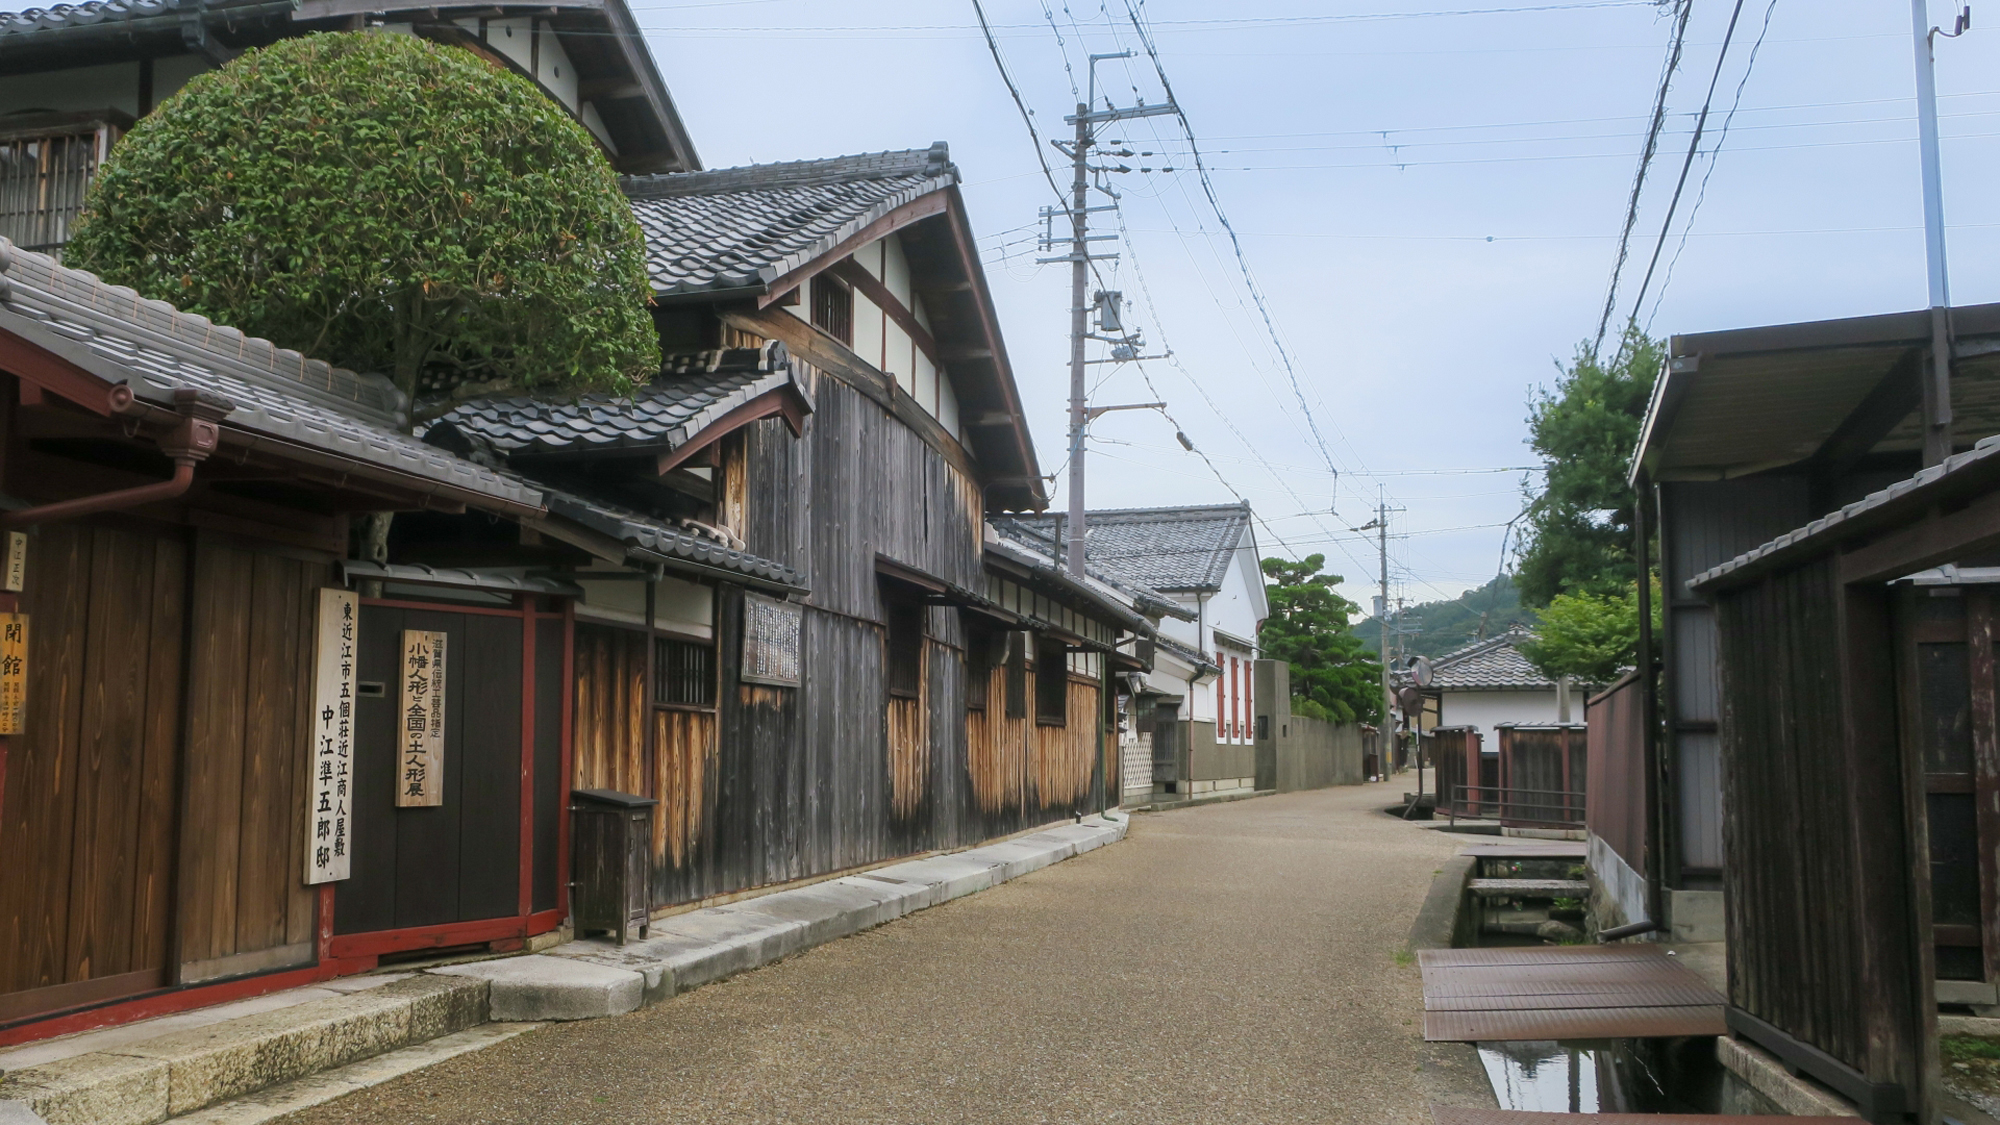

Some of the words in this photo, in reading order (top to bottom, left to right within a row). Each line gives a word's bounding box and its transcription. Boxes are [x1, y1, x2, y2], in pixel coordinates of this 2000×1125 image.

[316, 704, 335, 870] 中江準五郎邸
[334, 602, 353, 857] 東近江市五個荘近江商人屋敷
[404, 642, 429, 798] 小幡人形と全国の土人形展
